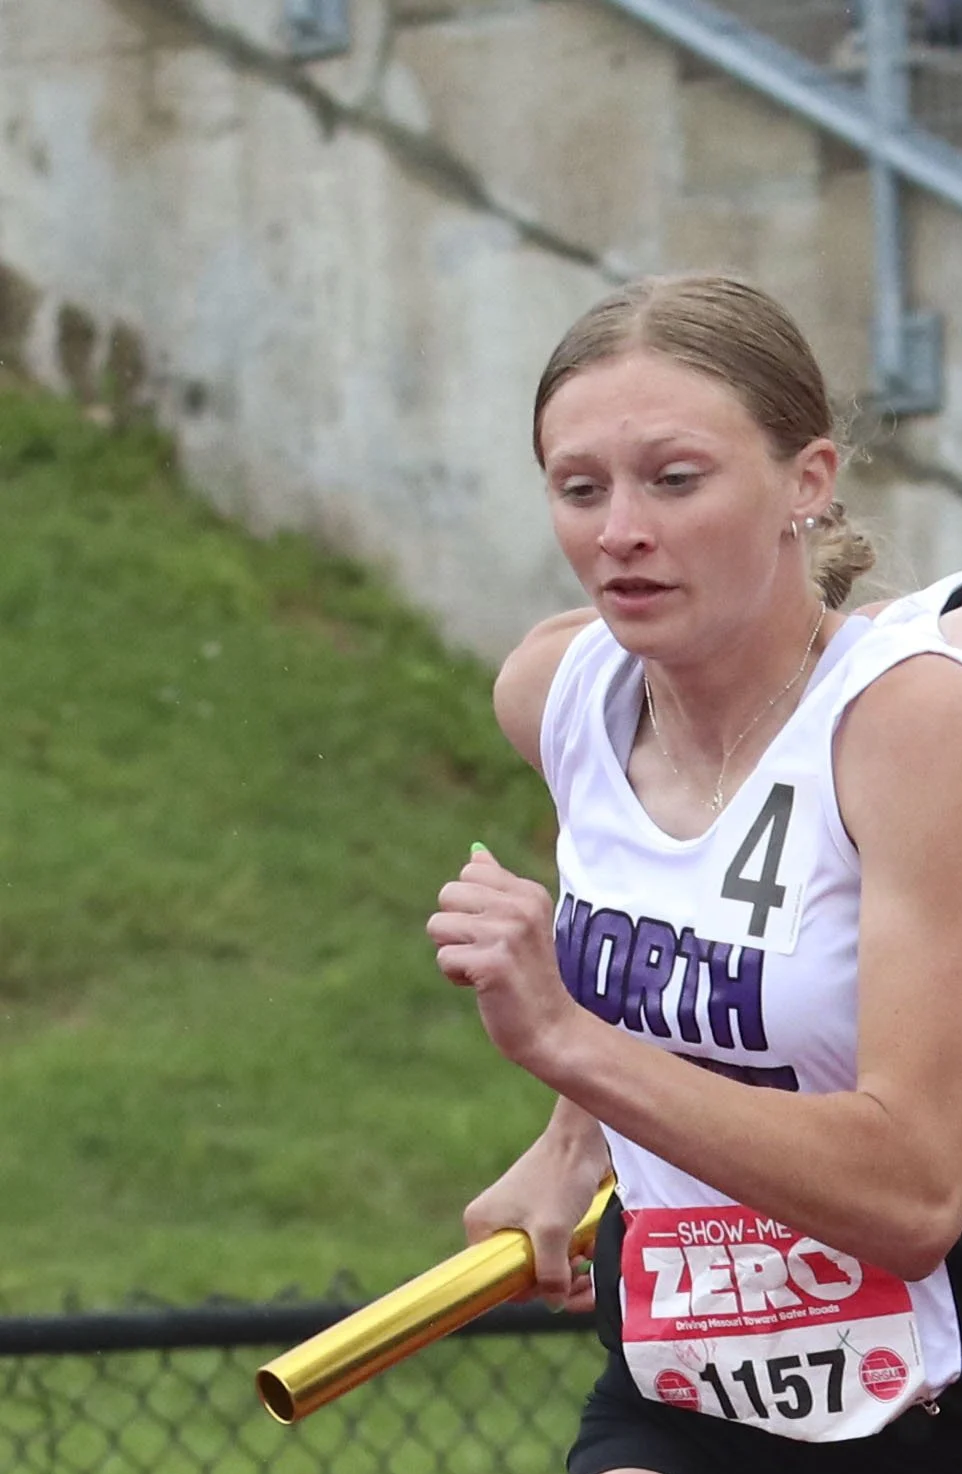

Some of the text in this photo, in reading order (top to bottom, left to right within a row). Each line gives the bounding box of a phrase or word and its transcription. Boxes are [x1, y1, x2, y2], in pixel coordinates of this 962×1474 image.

[720, 783, 794, 938] 4
[555, 892, 768, 1052] NORTH
[677, 1217, 792, 1246] SHOW-ME
[642, 1237, 863, 1319] ZERO
[675, 1319, 708, 1332] Driving
[709, 1317, 743, 1329] Missouri
[743, 1313, 778, 1327] Toward
[808, 1304, 840, 1316] Roads
[700, 1348, 847, 1420] 1157
